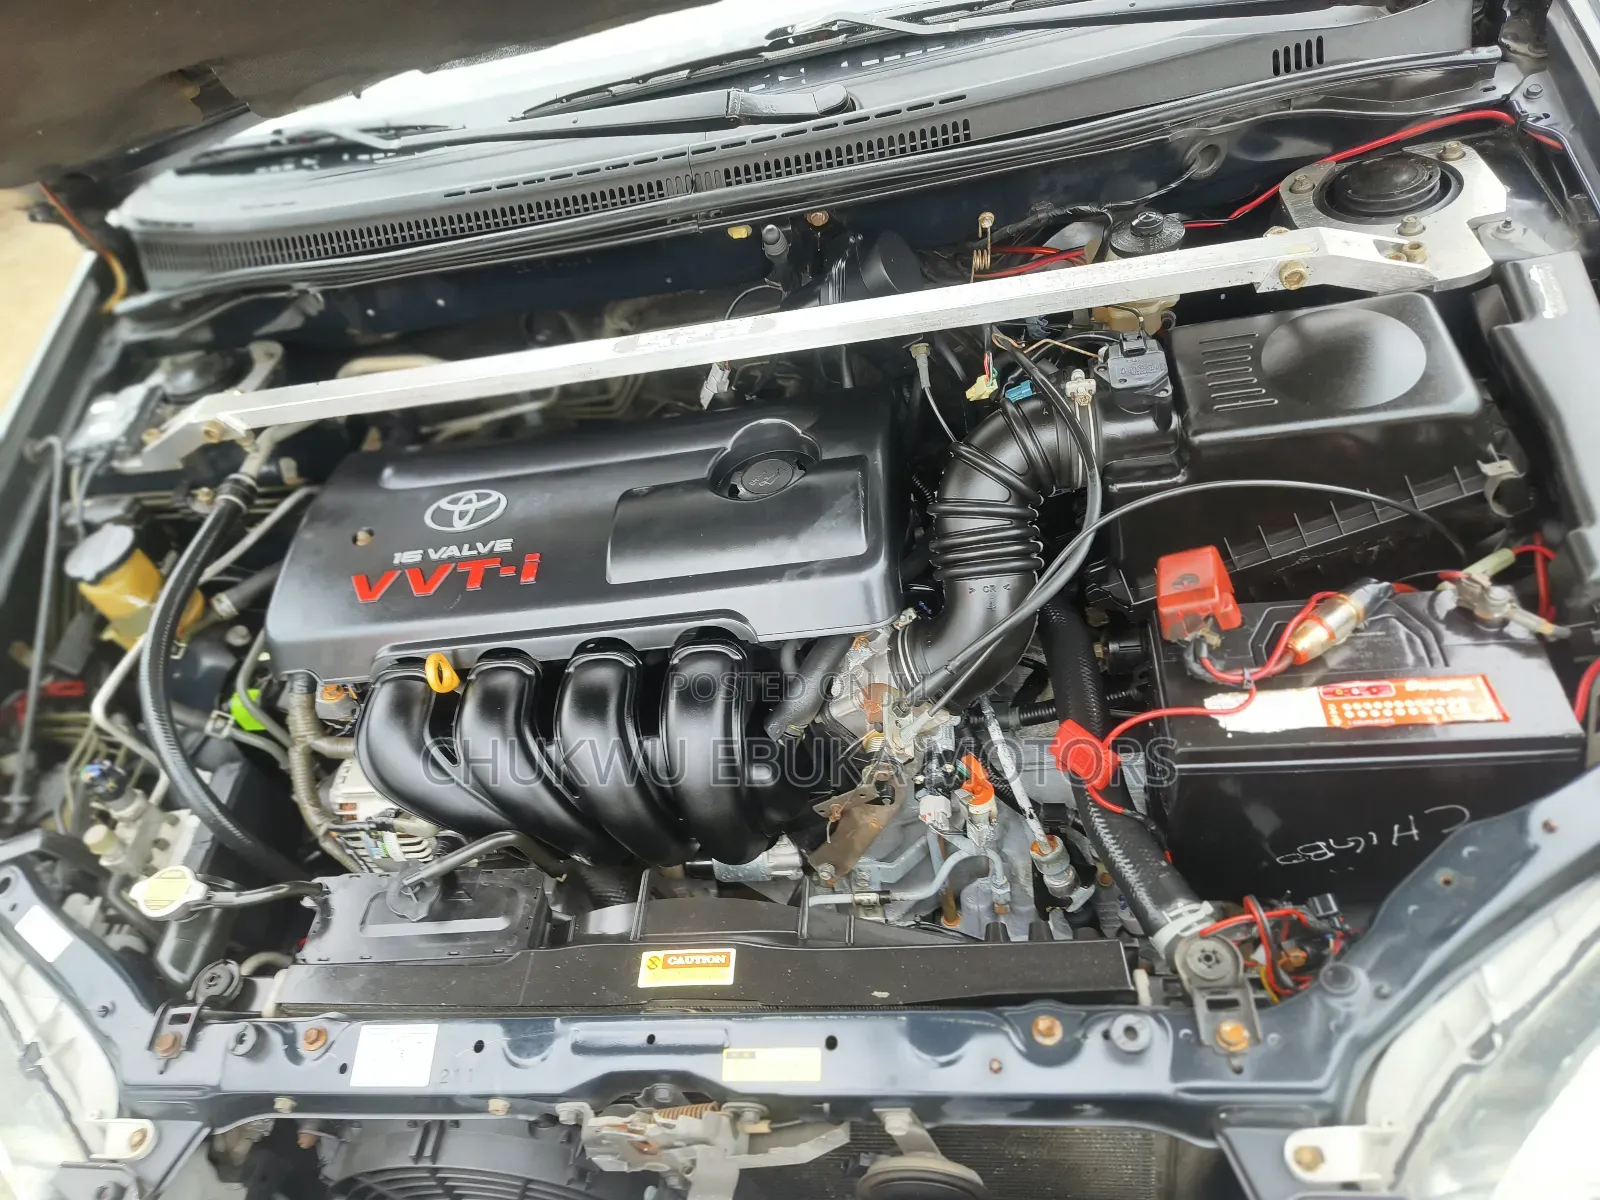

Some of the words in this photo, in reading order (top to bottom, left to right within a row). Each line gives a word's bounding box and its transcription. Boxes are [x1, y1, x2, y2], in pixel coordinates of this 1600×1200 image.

[392, 549, 424, 565] 16
[427, 537, 514, 561] VALVE
[351, 552, 542, 604] VVT-i
[666, 954, 728, 966] CAUTION
